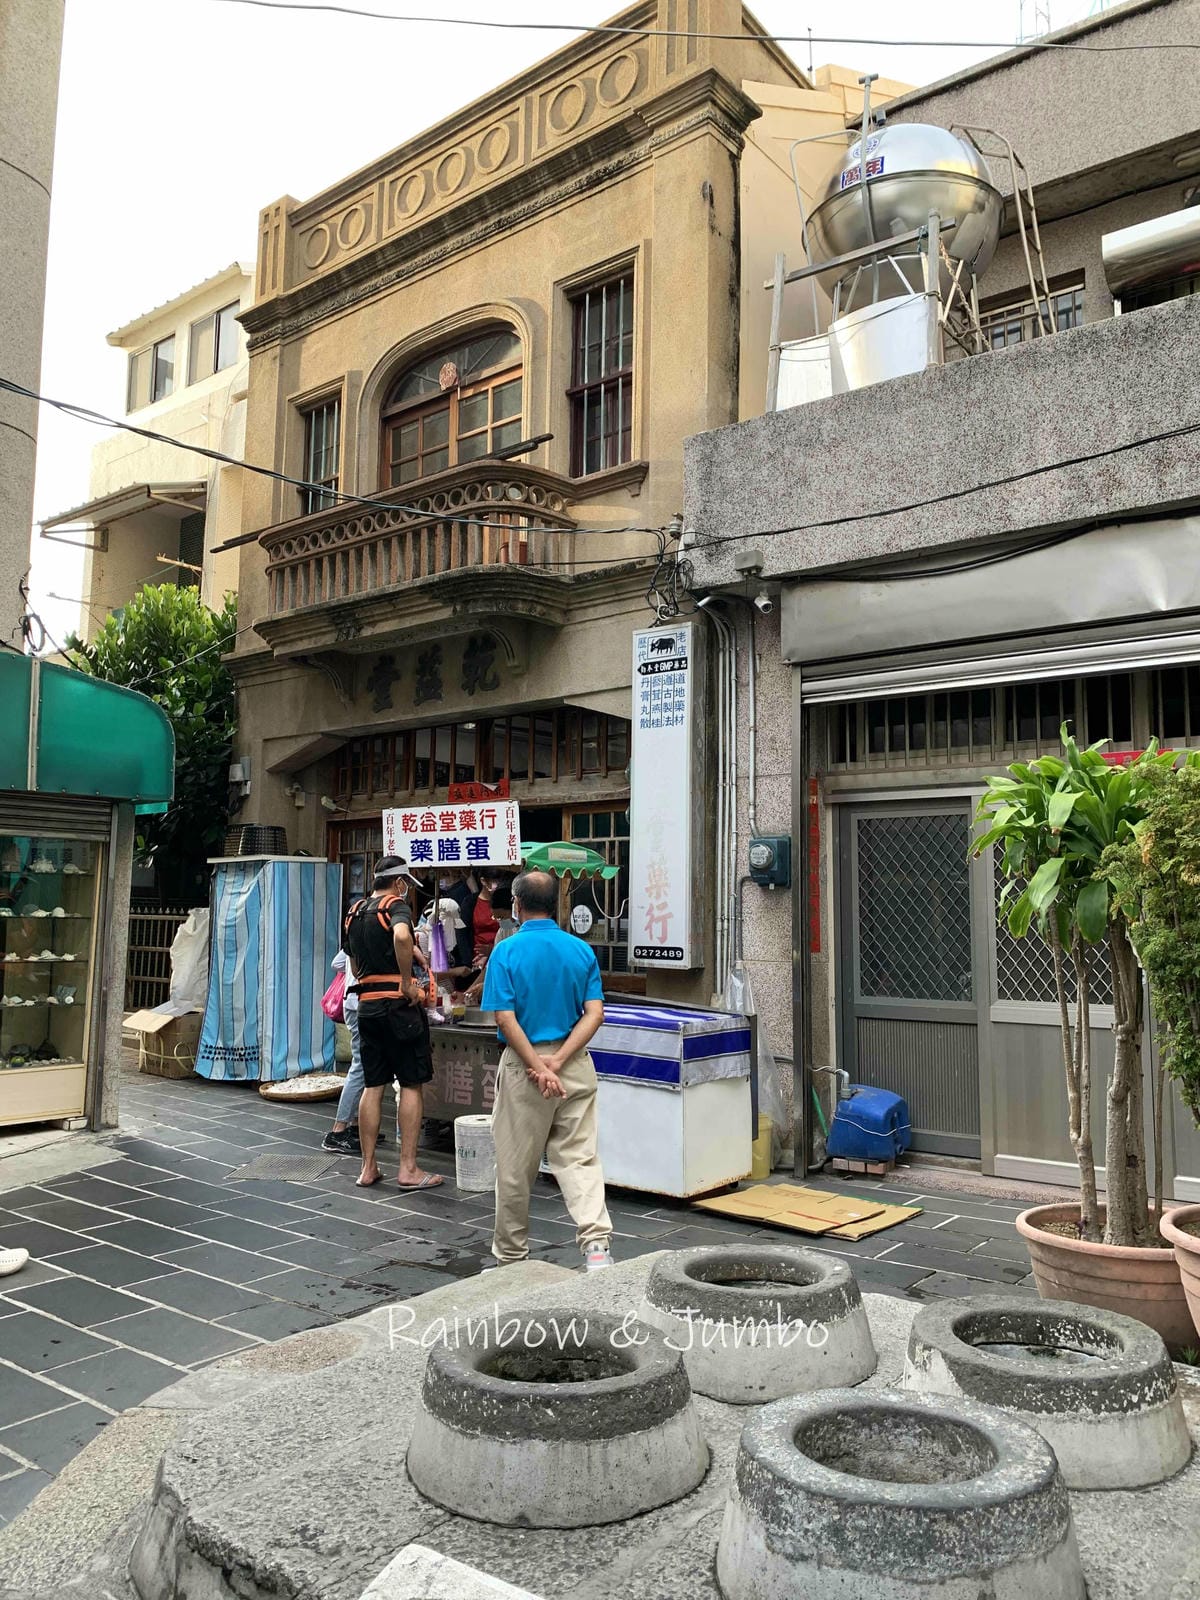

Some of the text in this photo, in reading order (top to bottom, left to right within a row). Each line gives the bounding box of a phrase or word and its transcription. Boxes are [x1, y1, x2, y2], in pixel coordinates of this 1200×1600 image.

[677, 631, 687, 656] 老店
[640, 677, 651, 730] 丹膏丸散
[675, 672, 686, 726] 道地藥材
[401, 808, 497, 834] 乾益堂藥行
[505, 805, 517, 861] 百年老店
[410, 836, 491, 863] 藥膳蛋
[635, 948, 682, 958] 9272489
